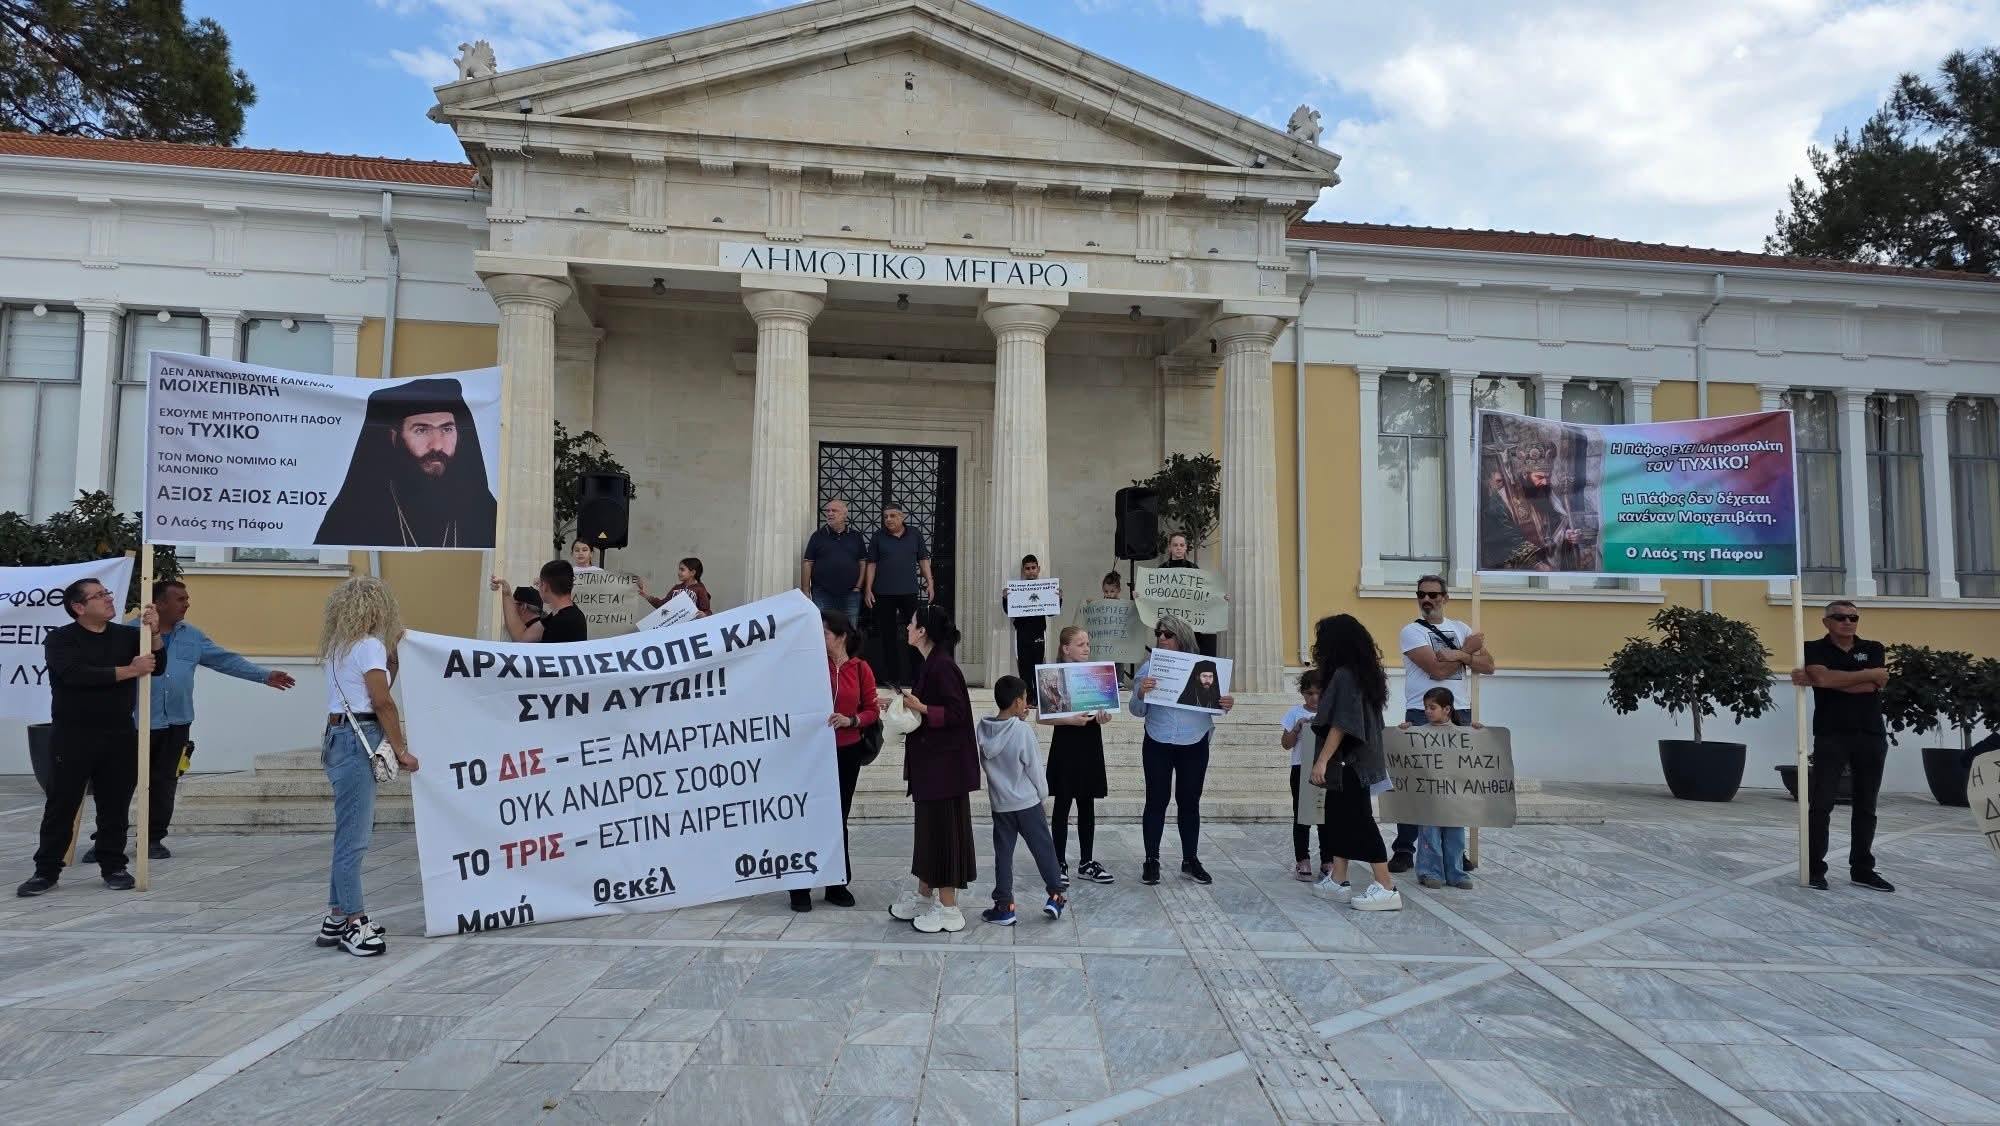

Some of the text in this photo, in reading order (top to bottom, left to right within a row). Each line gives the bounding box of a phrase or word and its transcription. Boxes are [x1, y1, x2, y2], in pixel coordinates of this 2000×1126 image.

[160, 367, 184, 377] ΔΕΝ
[159, 378, 280, 397] ΜΟΙΧΕΠΙΒΑΤΗ
[159, 408, 342, 425] ΕΧΟΥΜΕ ΜΗΤΡΟΠΟΛΙΤΗ ΠΑΦΟΥ
[159, 422, 260, 440] ΤΟΝ ΤΥΧΙΚΟ
[1611, 443, 1622, 455] Η
[1624, 442, 1669, 457] Πάφος
[1698, 441, 1784, 455] Μητροπολίτη
[158, 451, 297, 467] ΤΟΝ ΜΟΝΟ ΝΟΜΙΜΟ ΚΑΙ
[1646, 455, 1749, 472] τον ΤΥΧΙΚΟ!
[158, 464, 219, 476] ΚΑΝΟΝΙΚΟ
[157, 485, 328, 506] ΑΞΙΟΣ ΑΞΙΟΣ ΑΞΙΟΣ
[1622, 492, 1771, 506] Η Πάφος δεν δέχεται
[156, 515, 284, 531] Ο Λαός της Πάφου
[1618, 510, 1777, 526] κανέναν Μοιχεπιβάτη.
[1626, 547, 1764, 562] Ο Λαός της Πάφου
[1148, 574, 1204, 589] ΕΙΜΑΣΤΕ
[443, 633, 714, 679] ΑΡΧΙΕΠΙΣΚΟΠΕ
[720, 614, 777, 653] ΚΑΙ
[518, 667, 728, 722] ΣΥΝ ΑΥΤΩ!!!
[450, 759, 488, 790] ΤΟ
[498, 747, 546, 782] ΔΙΣ
[580, 737, 613, 767] ΕΞ
[622, 713, 792, 761] ΑΜΑΡΤΑΝΕΙΝ
[1386, 753, 1500, 770] ΙΜΑΣΤΕ ΜΑΖΙ
[499, 758, 762, 826] ΟΥΚ ΑΝΔΡΟΣ ΣΟΦΟΥ
[1415, 777, 1457, 795] ΣΤΗΝ
[452, 848, 490, 881] ΤΟ
[499, 832, 566, 870] ΤΡΙΣ
[600, 813, 671, 849] ΕΣΤΙΝ
[680, 792, 809, 836] ΑΙΡΕΤΙΚΟΥ
[457, 848, 819, 935] Μανή Θεκέλ Φάρες
